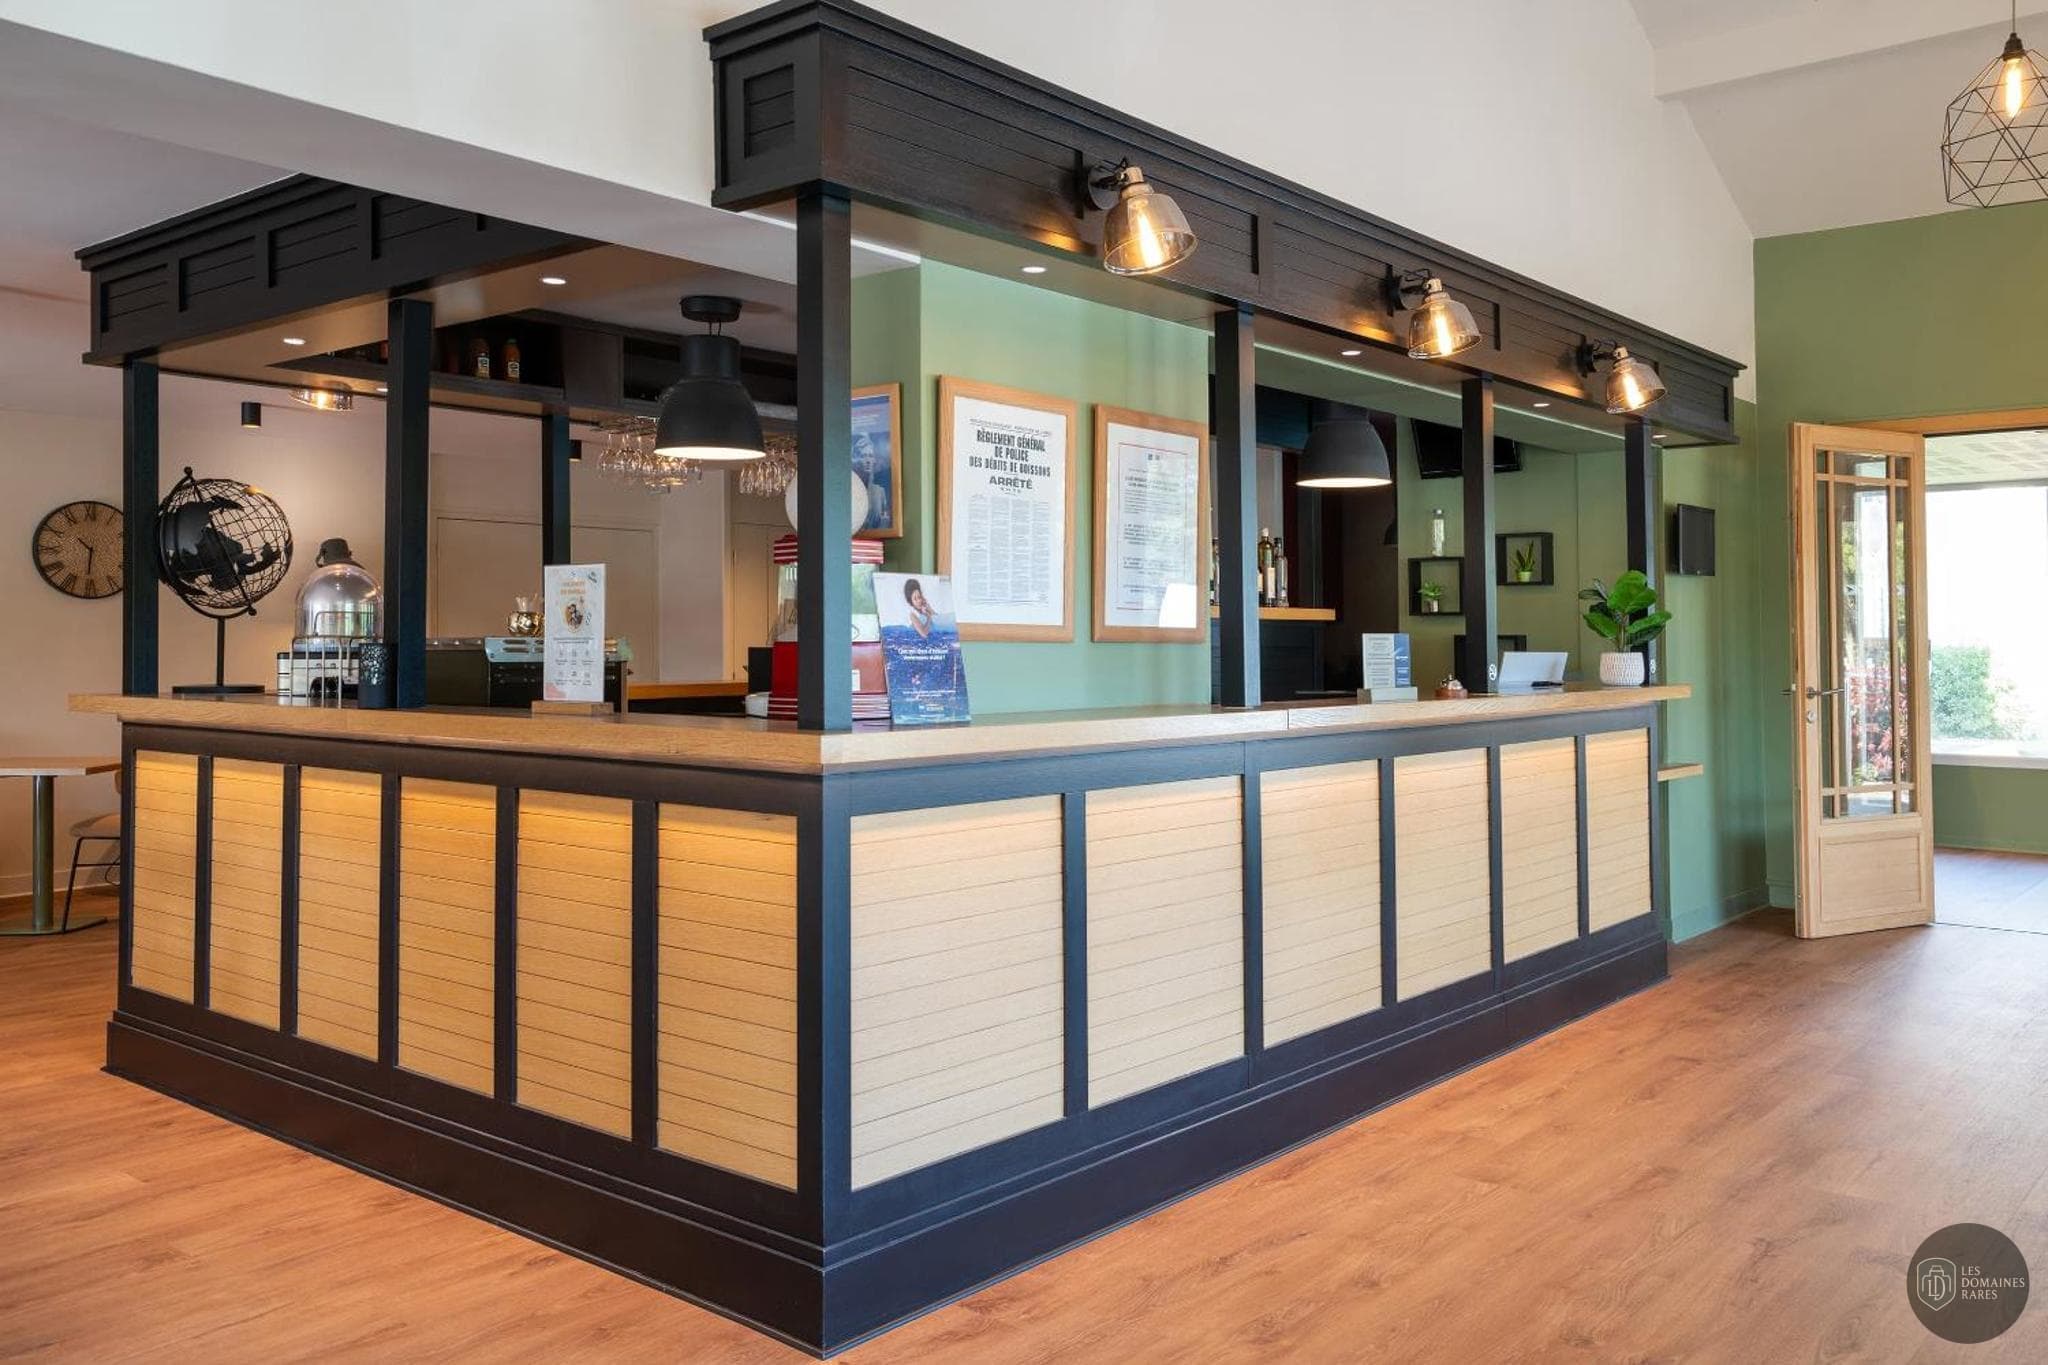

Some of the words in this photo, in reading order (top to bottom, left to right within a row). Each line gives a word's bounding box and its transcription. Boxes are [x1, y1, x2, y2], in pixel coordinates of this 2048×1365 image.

[977, 427, 1016, 447] RÈGLEMENT
[994, 446, 1003, 458] DE
[1005, 447, 1029, 462] POLICE
[969, 455, 983, 468] DES
[1010, 462, 1018, 473] DE
[1019, 463, 1051, 477] BOISSONS
[989, 475, 1033, 490] ARRÊTÉ
